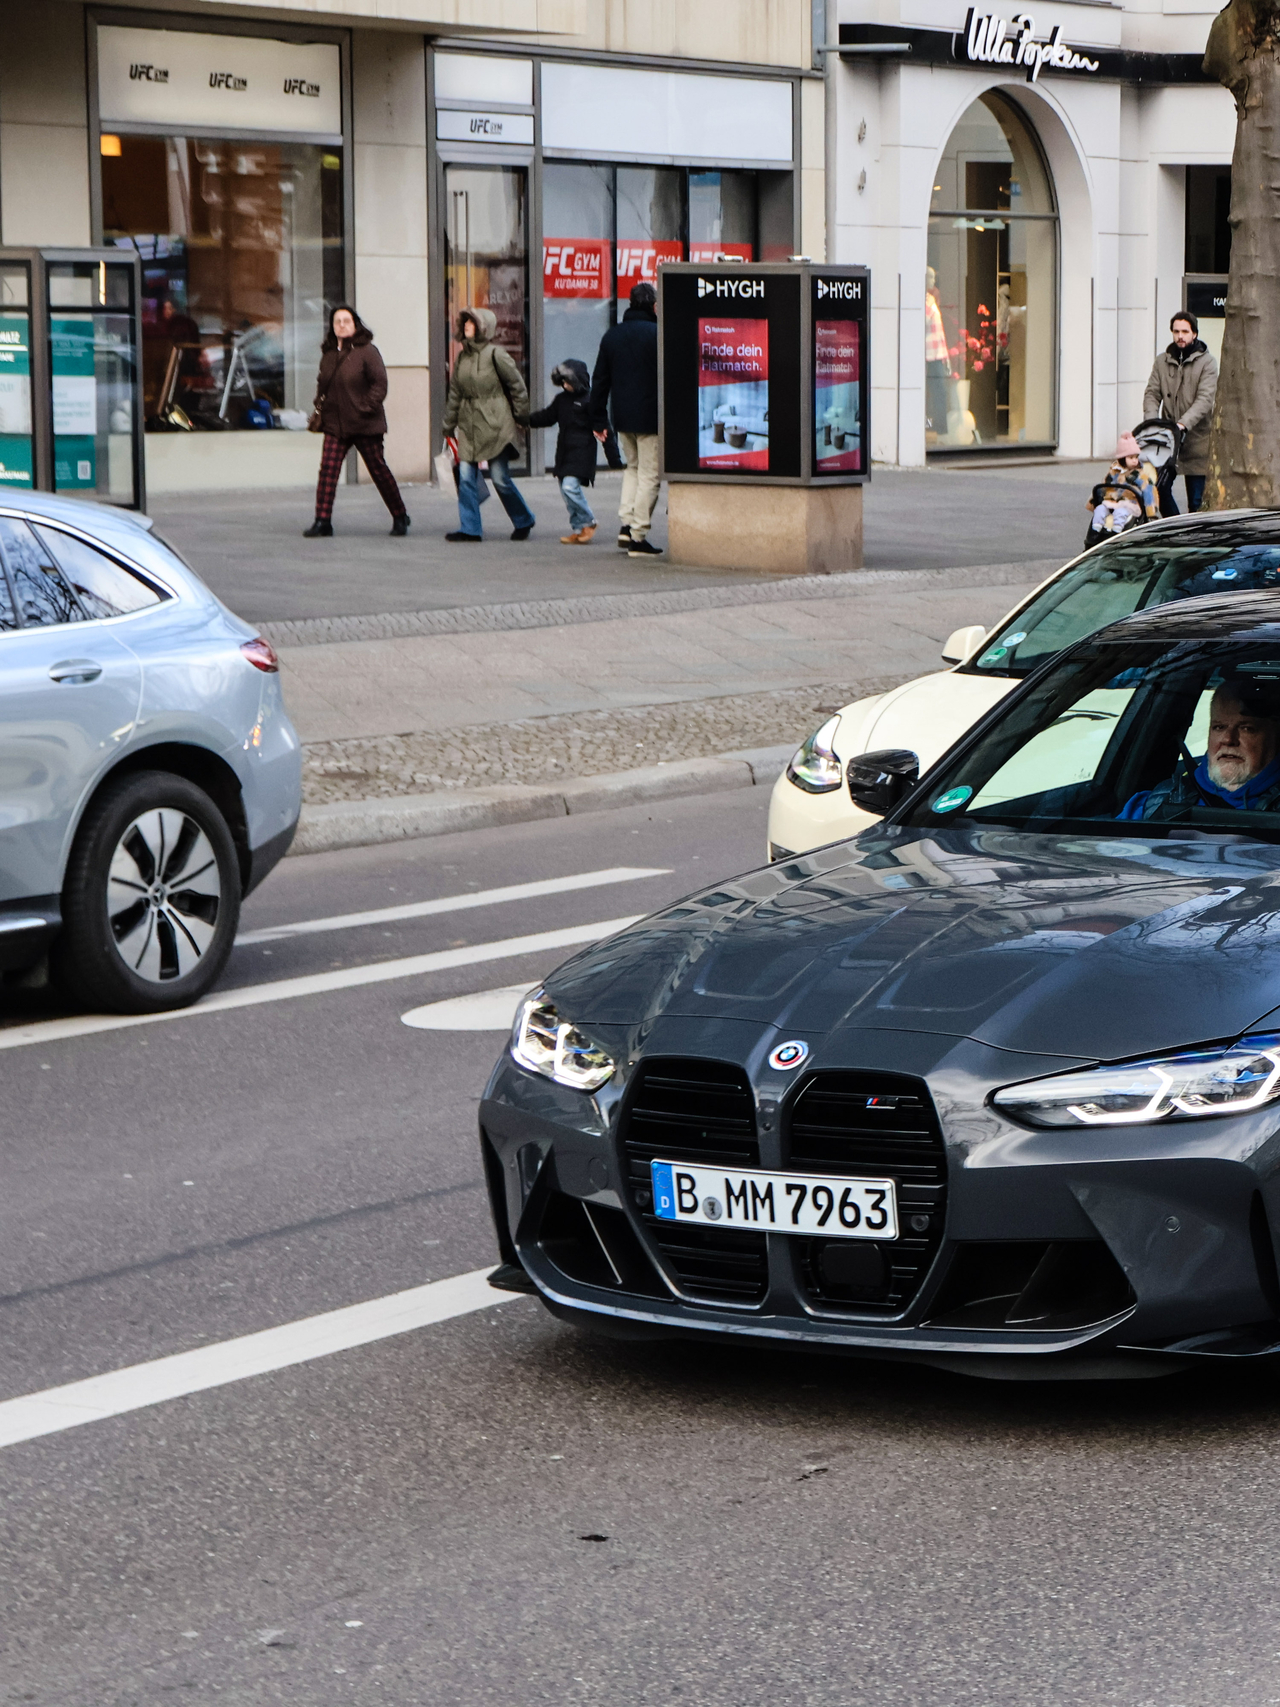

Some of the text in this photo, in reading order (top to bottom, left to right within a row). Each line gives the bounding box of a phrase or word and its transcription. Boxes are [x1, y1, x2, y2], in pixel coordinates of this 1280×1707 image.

[966, 6, 1100, 83] Ulla Popken
[129, 64, 154, 82] UFC
[209, 72, 233, 90] UFC
[283, 78, 307, 95] UFC
[470, 118, 490, 134] UFC
[574, 252, 601, 271] GYM
[616, 248, 656, 277] UFC
[716, 279, 765, 298] HYGH
[829, 281, 861, 299] HYGH
[701, 342, 763, 357] Finde dein
[815, 342, 854, 358] Finde dein
[701, 360, 763, 372] Flatmatch.
[661, 1172, 889, 1230] D B MM 7963
